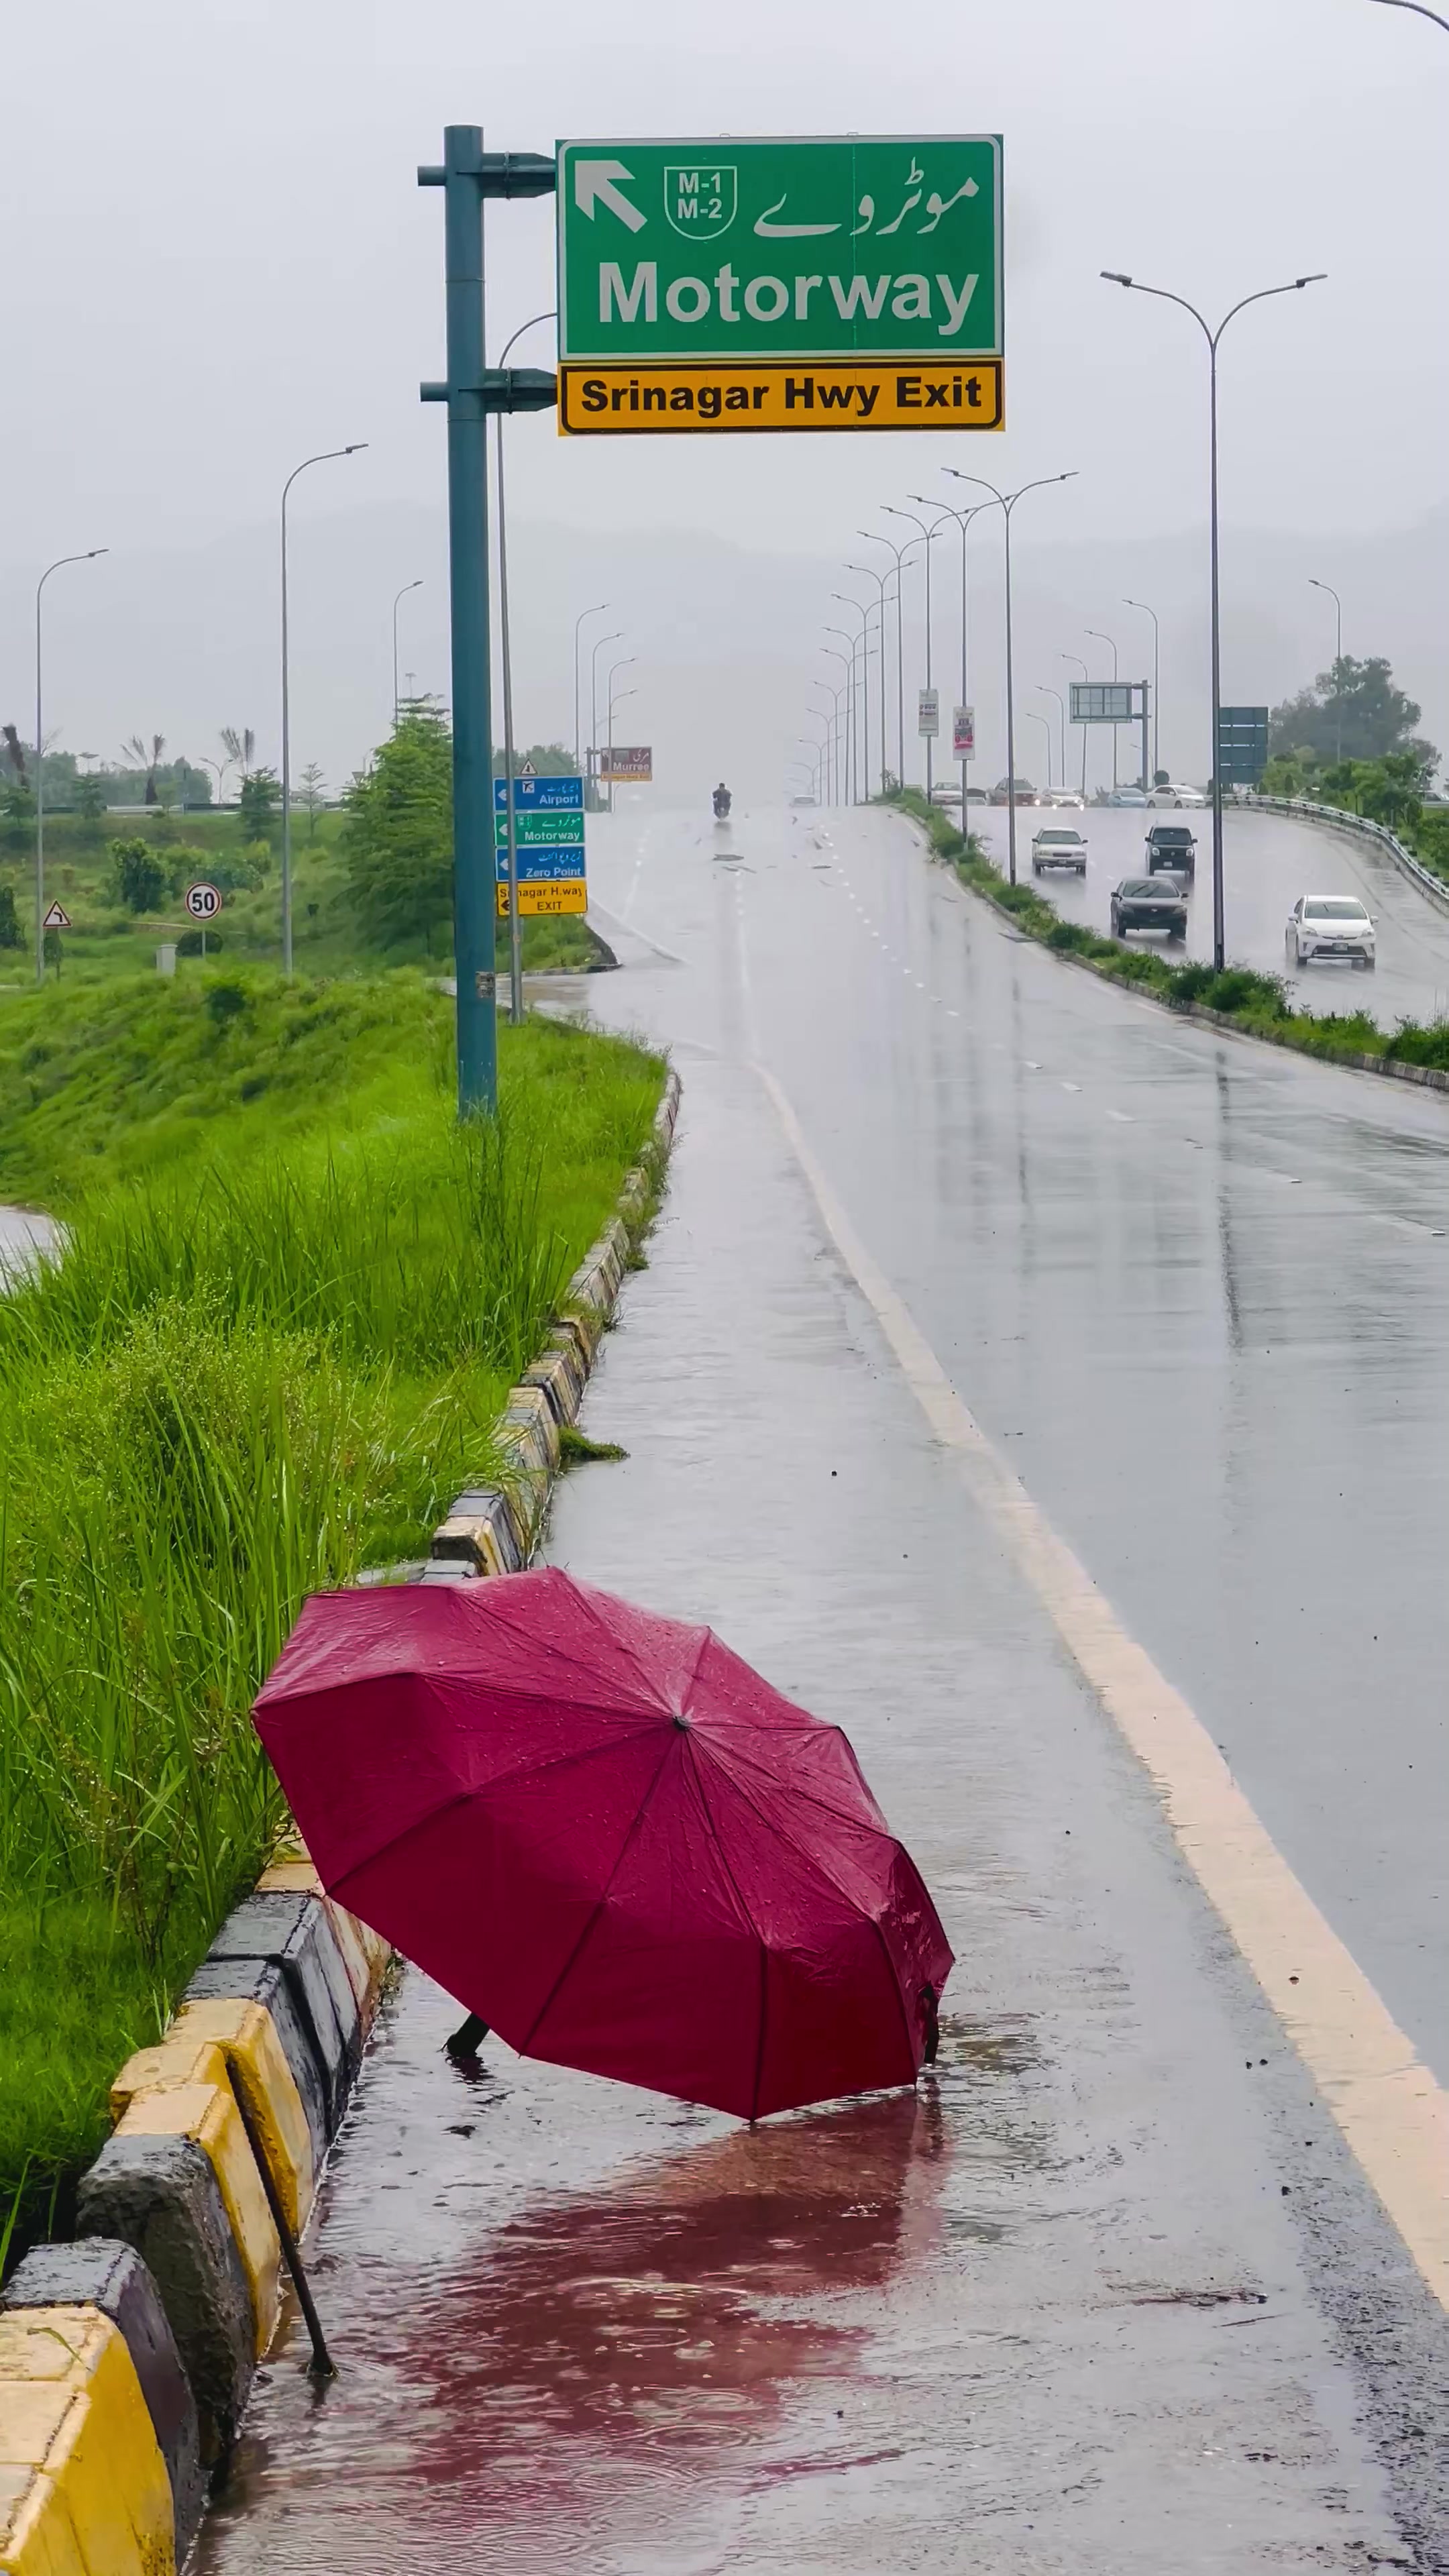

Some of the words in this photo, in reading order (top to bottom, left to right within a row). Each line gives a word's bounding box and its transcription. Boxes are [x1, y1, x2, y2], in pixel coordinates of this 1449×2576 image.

[678, 172, 722, 194] M-1
[677, 198, 722, 219] M-2
[598, 261, 979, 335] Motorway
[581, 379, 769, 419] Srinagar
[784, 377, 880, 417] Hwy
[896, 376, 983, 409] Exit
[539, 794, 579, 805] Airport
[525, 831, 580, 841] Motorway
[526, 867, 550, 877] Zero
[554, 867, 581, 876] Point
[192, 892, 215, 912] 50
[537, 901, 562, 910] EXIT
